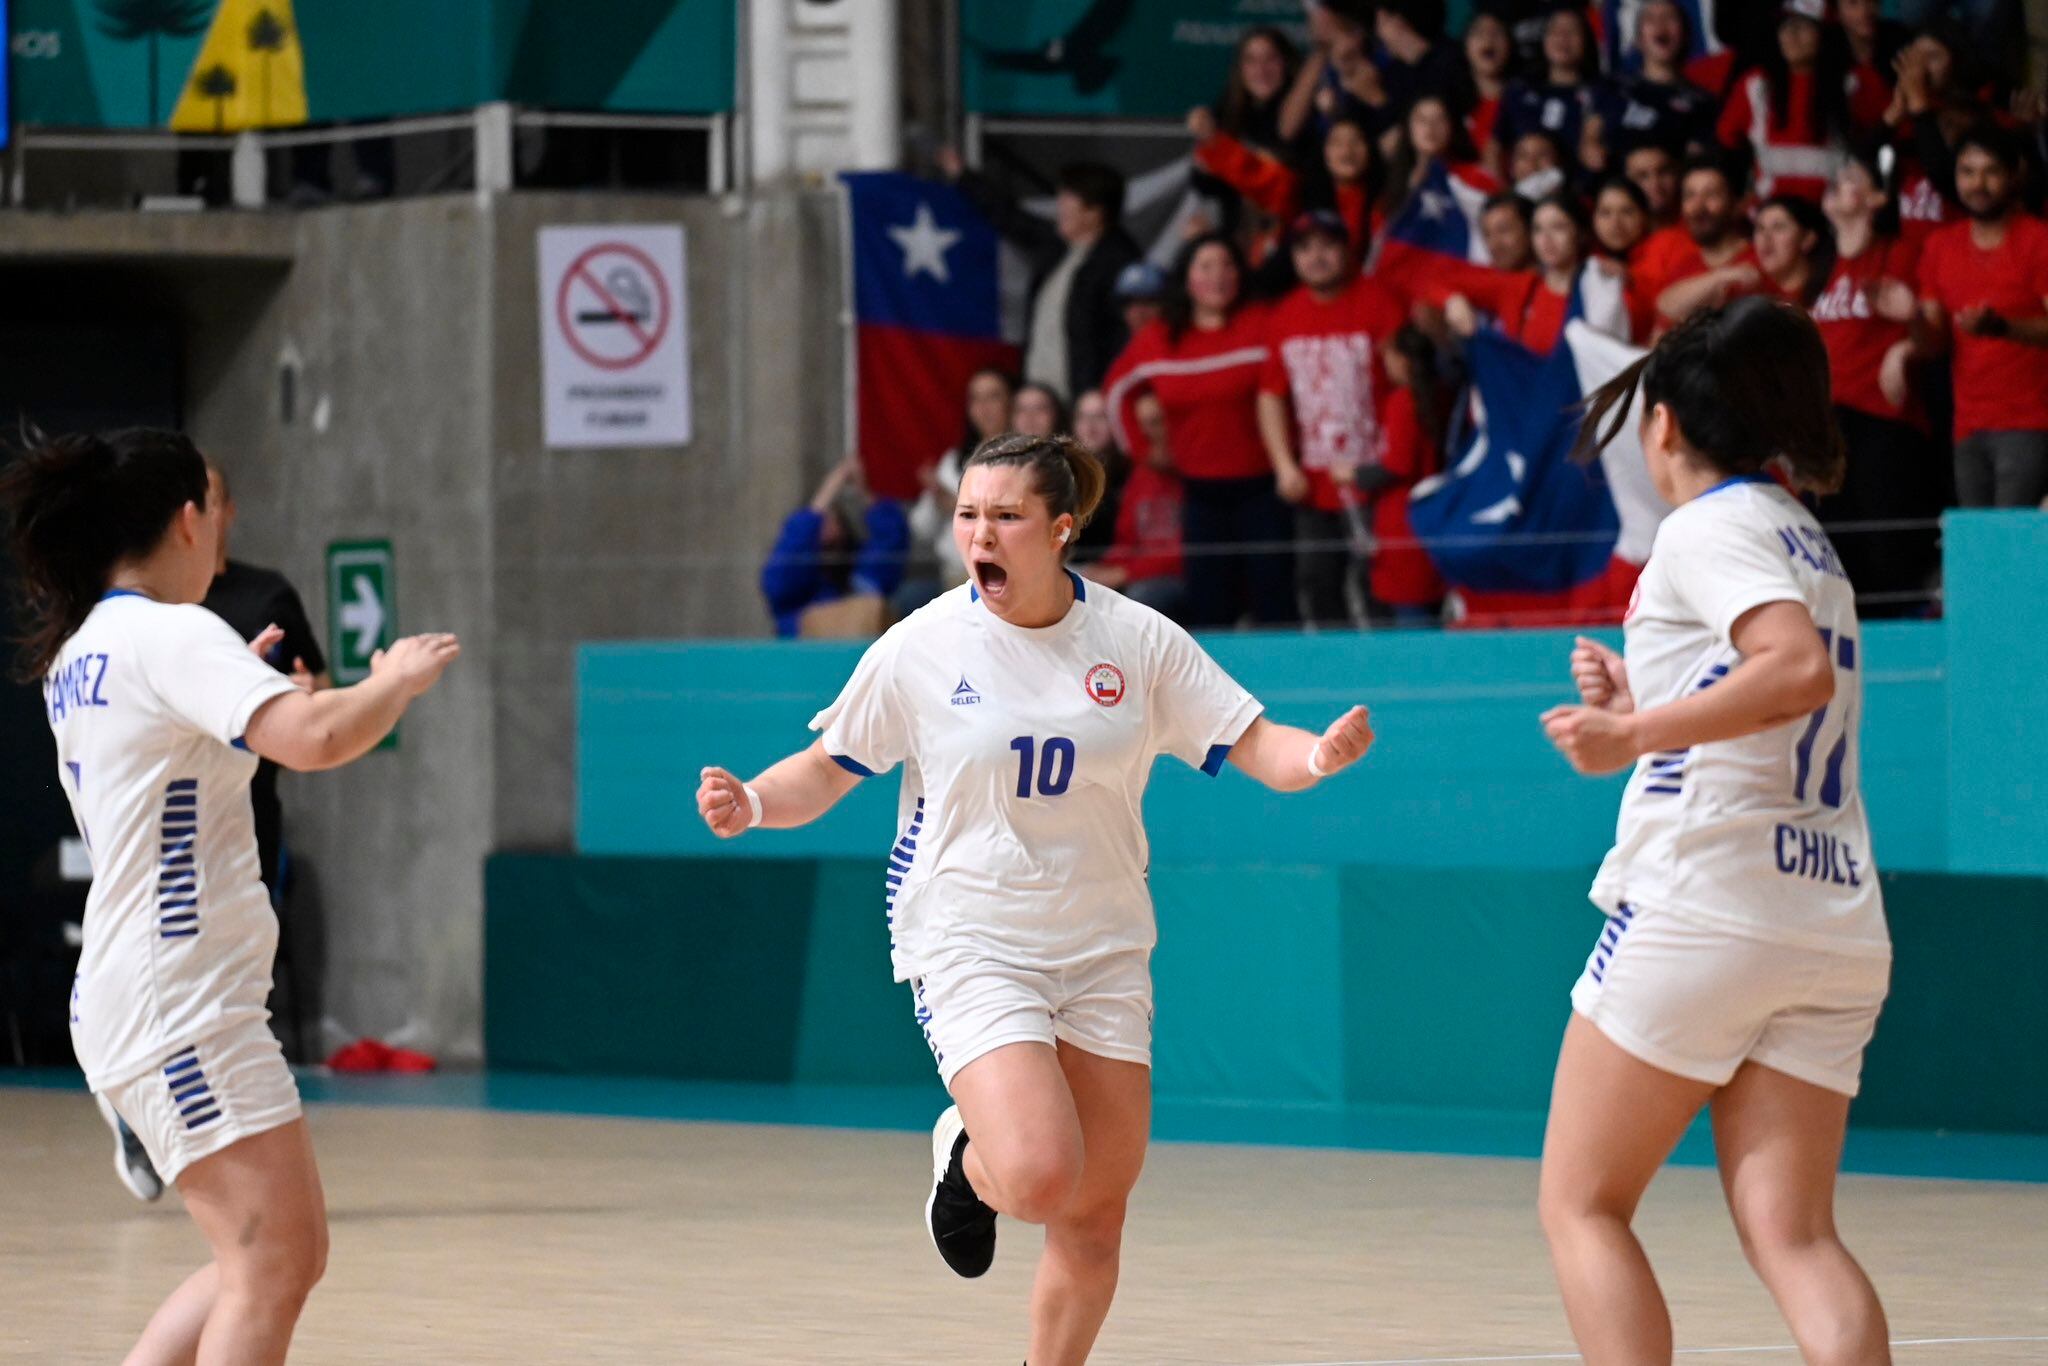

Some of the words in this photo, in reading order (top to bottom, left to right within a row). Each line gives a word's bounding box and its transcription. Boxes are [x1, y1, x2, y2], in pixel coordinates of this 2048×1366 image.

[951, 696, 981, 705] SELECT
[1010, 735, 1075, 798] 10
[1775, 822, 1861, 887] CHILE
